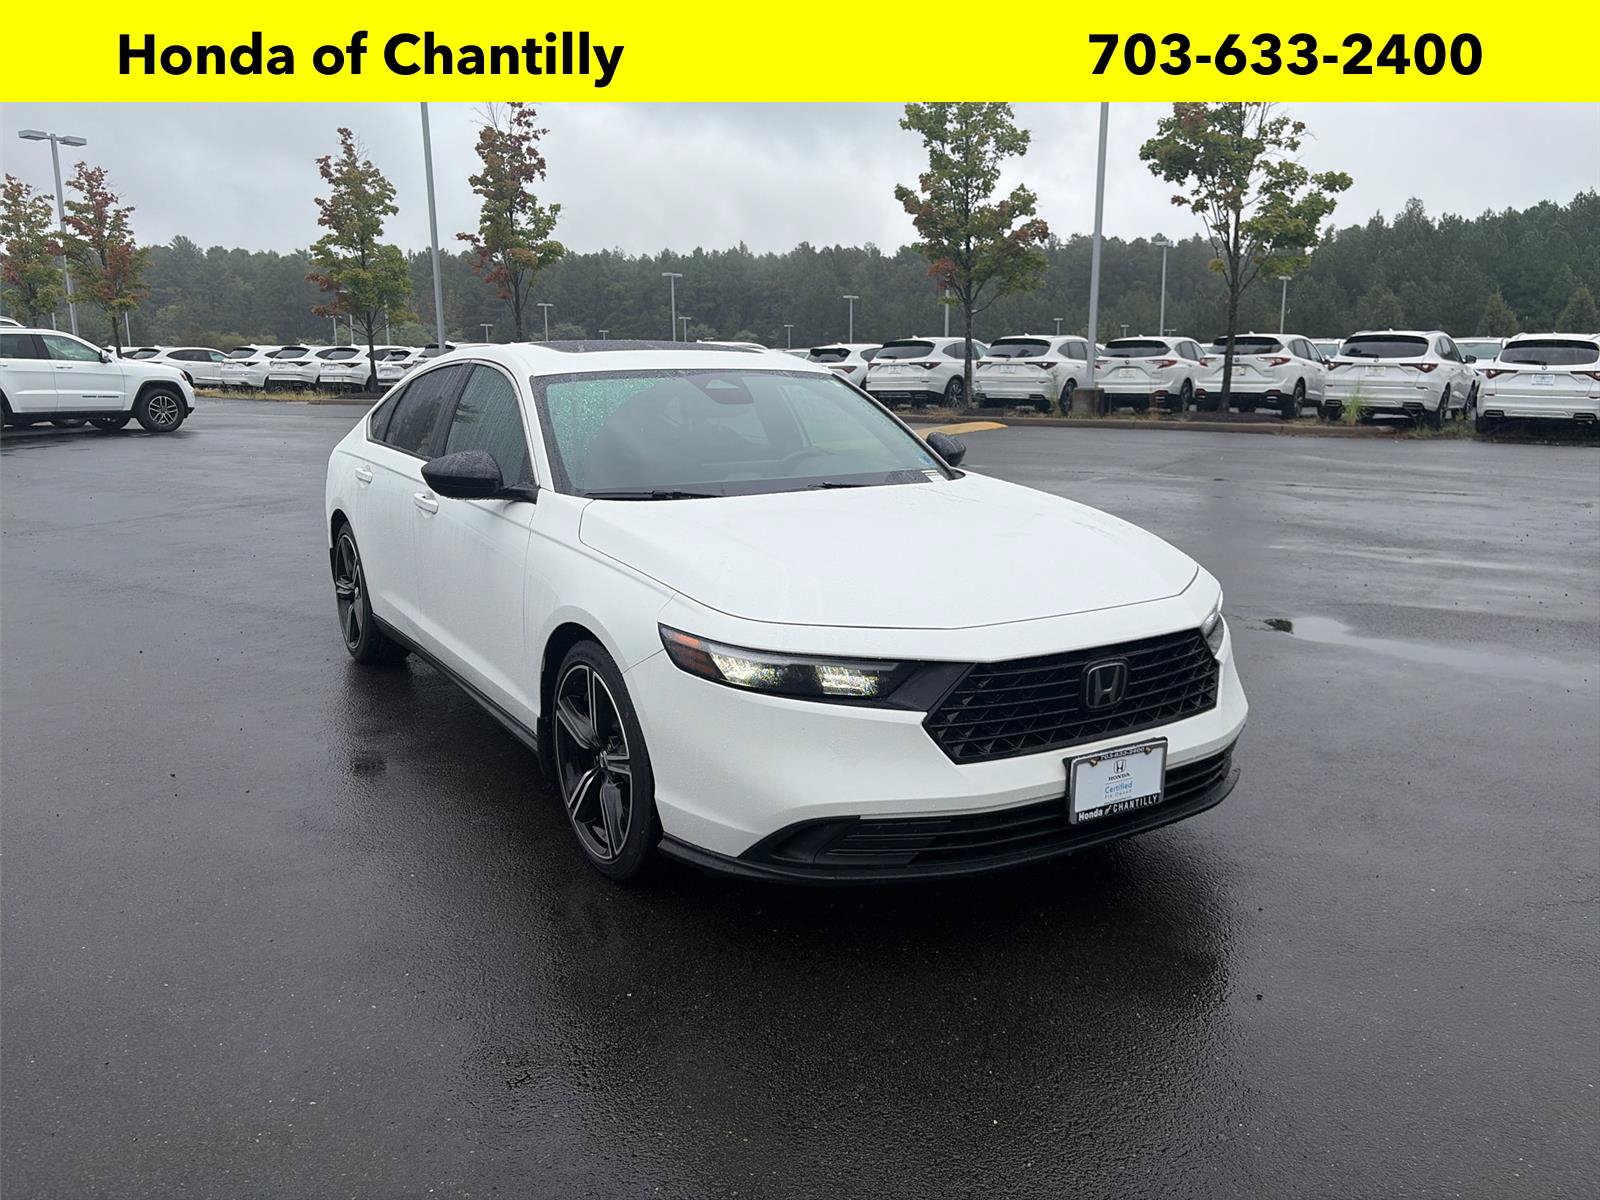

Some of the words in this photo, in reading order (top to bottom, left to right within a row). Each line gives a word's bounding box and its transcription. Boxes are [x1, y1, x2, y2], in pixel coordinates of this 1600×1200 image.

[1108, 772, 1131, 781] HONDA
[1104, 782, 1133, 794] Certified
[1078, 808, 1103, 822] Honda
[1113, 794, 1158, 813] CHANTILLY
